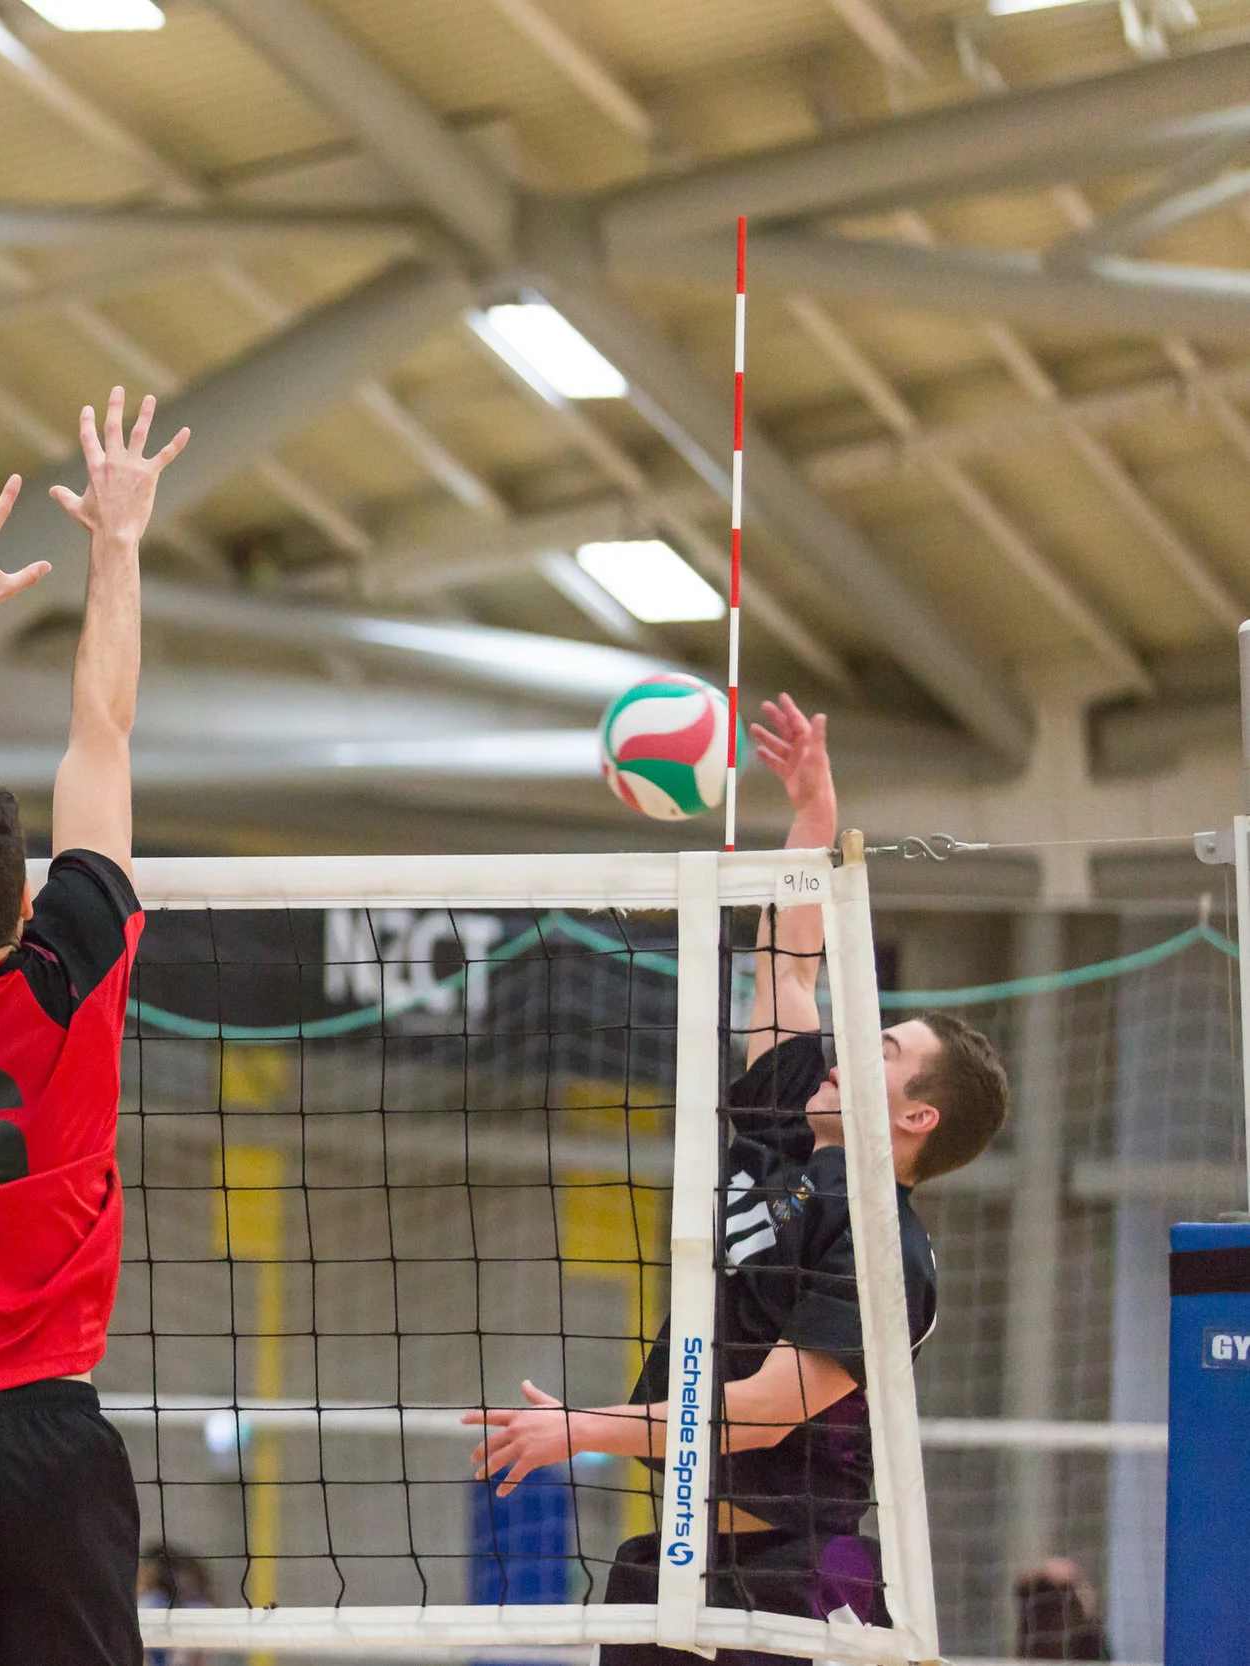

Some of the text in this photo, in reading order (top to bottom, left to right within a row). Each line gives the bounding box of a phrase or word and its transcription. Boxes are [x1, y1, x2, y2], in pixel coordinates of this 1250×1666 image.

[784, 870, 819, 892] 9/10
[672, 1337, 703, 1537] Schelde Sports
